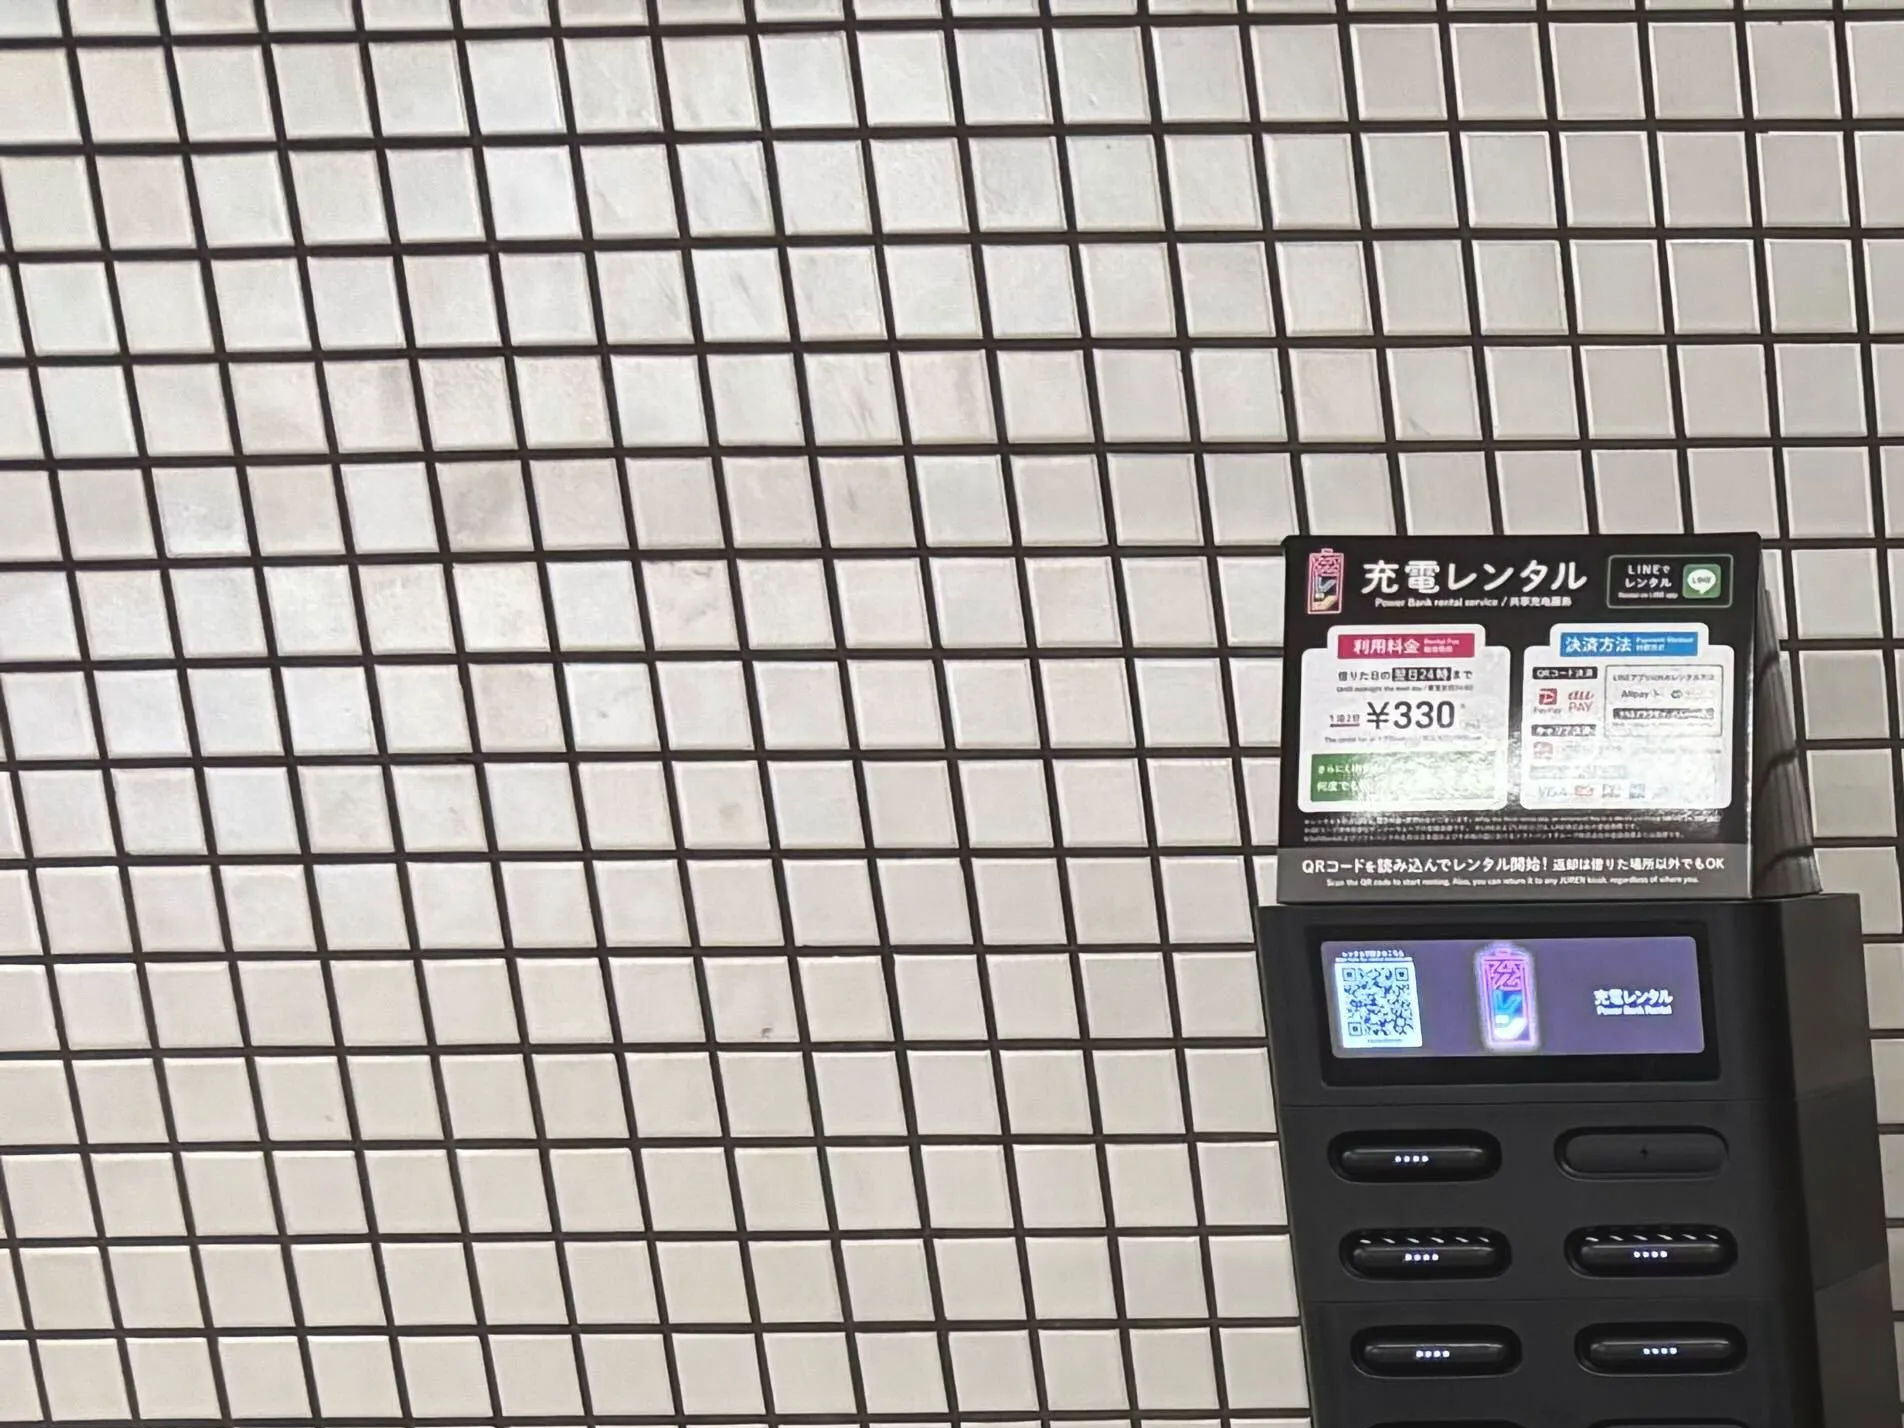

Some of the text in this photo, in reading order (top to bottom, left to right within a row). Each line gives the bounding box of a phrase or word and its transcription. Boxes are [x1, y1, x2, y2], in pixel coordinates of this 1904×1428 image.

[1361, 559, 1588, 595] 充電レンタル
[1625, 578, 1672, 589] レンタル
[1353, 638, 1420, 655] 利用料金
[1565, 637, 1632, 653] 決済方法
[1367, 700, 1455, 730] ¥330
